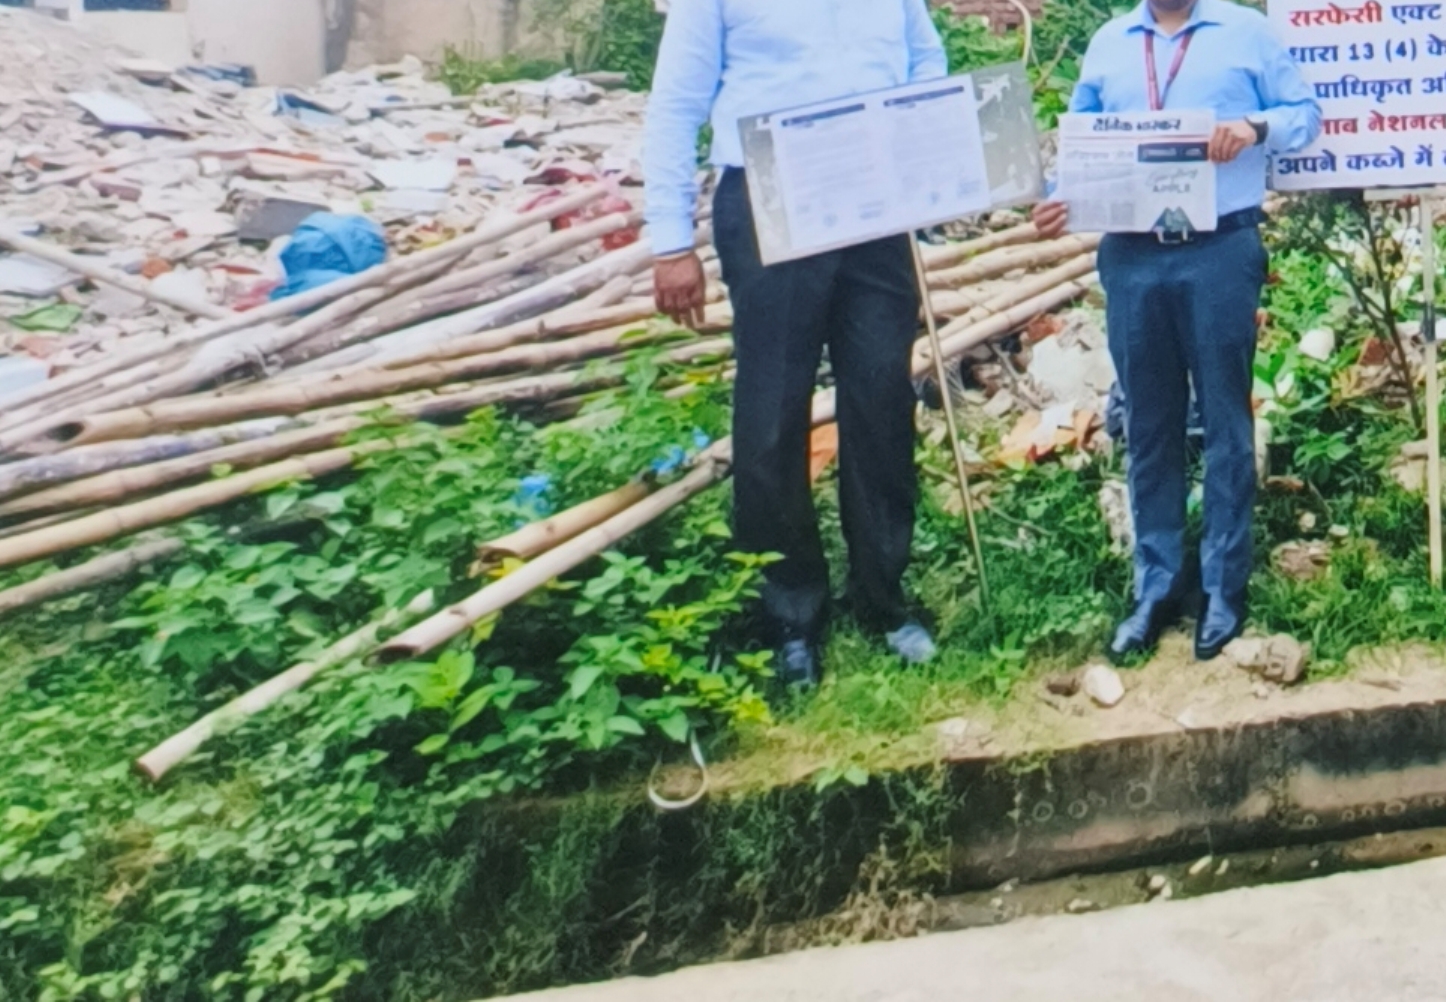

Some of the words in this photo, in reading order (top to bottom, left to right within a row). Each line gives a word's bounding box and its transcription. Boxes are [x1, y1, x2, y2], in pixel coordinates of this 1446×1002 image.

[1291, 0, 1382, 26] सरफेसी
[1392, 4, 1441, 24] एक्ट
[1349, 43, 1374, 61] 13
[1386, 39, 1416, 61] (4)
[1277, 148, 1336, 175] अपने
[1415, 145, 1432, 166] में
